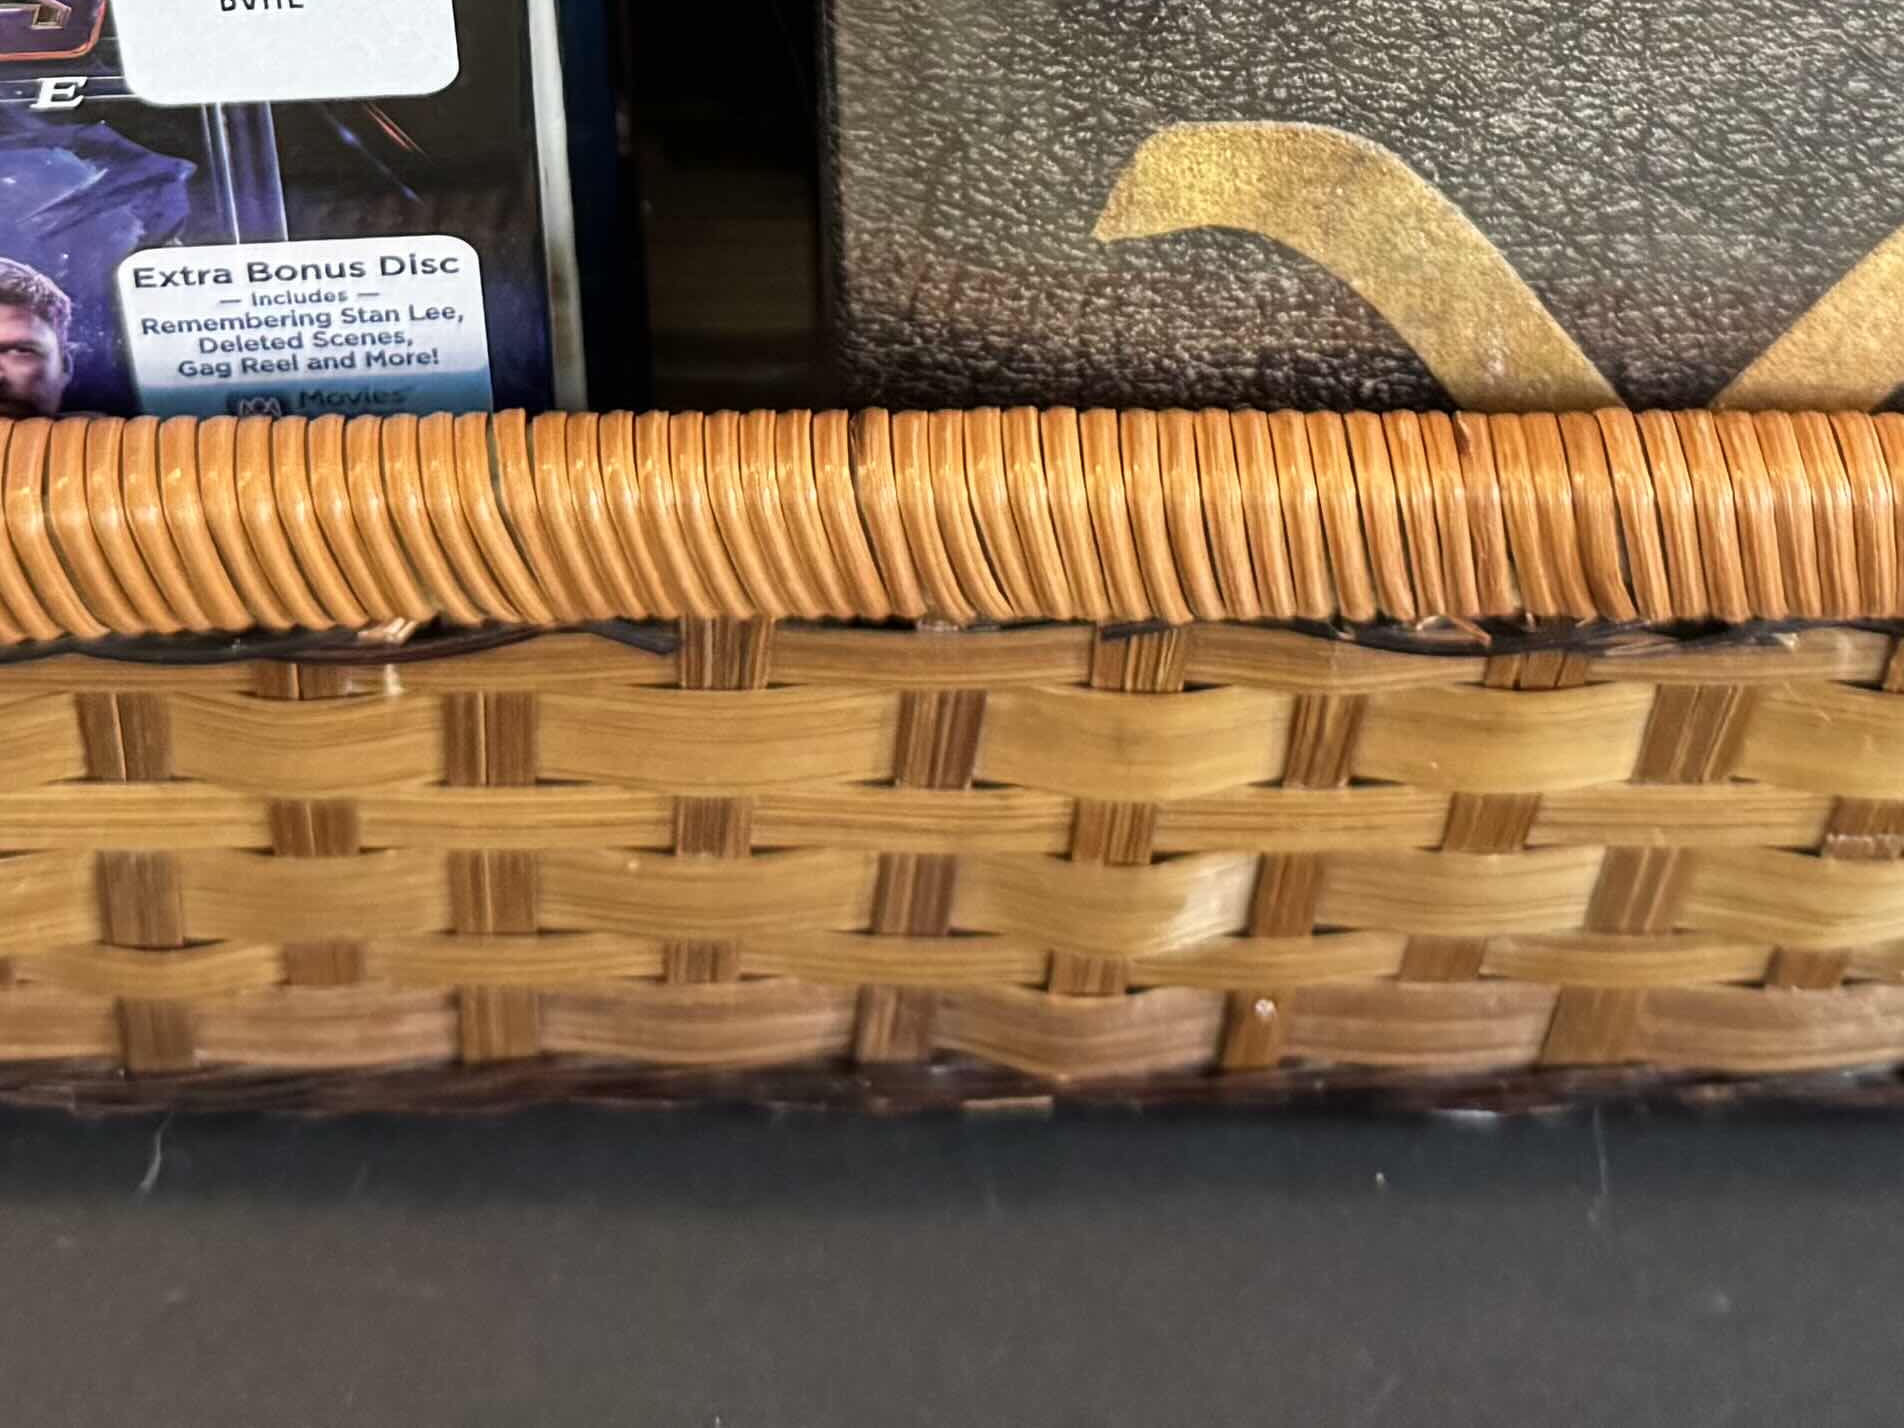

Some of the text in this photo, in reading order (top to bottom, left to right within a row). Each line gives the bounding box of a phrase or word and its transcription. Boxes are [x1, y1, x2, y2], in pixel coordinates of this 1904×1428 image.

[132, 253, 462, 289] Extra Bonus Disc
[250, 287, 350, 307] Includes
[140, 302, 465, 338] Remembering Stan Lee,
[197, 327, 414, 355] Deleted Scenes,
[177, 347, 440, 380] Gag Reel and More!
